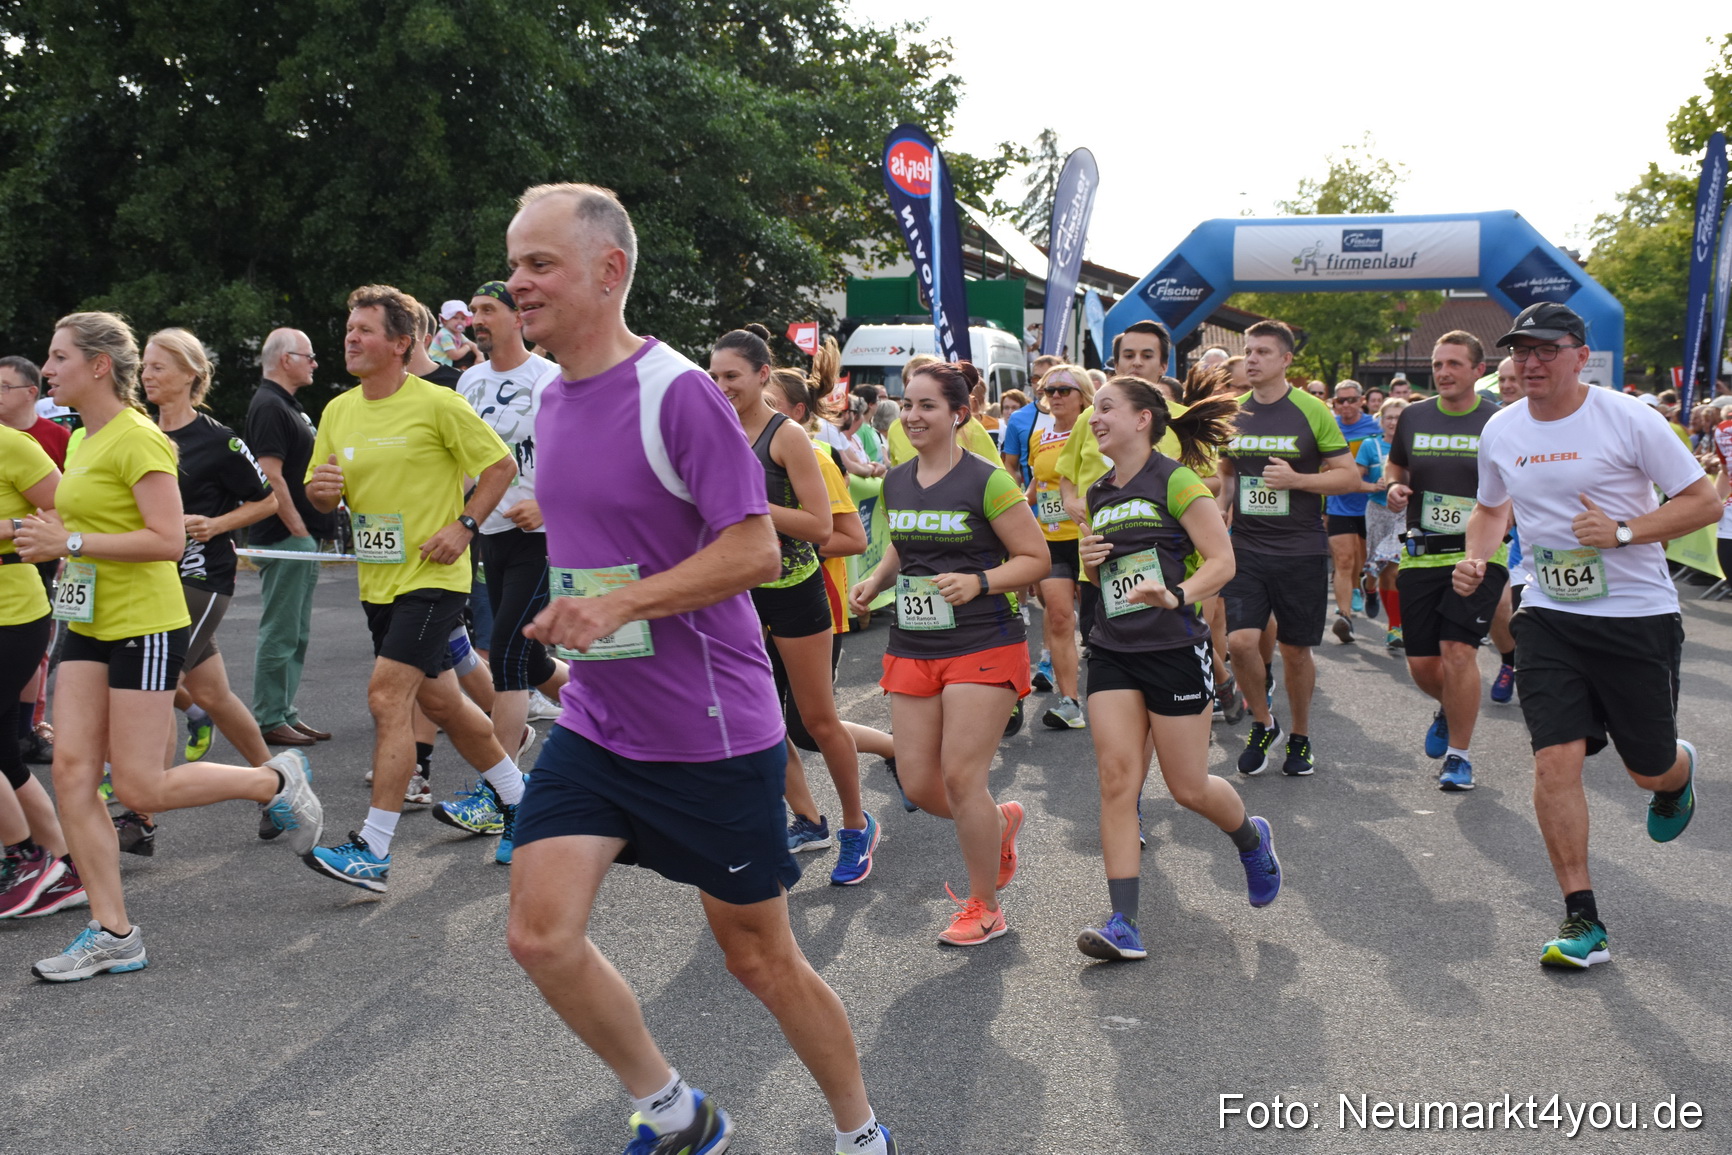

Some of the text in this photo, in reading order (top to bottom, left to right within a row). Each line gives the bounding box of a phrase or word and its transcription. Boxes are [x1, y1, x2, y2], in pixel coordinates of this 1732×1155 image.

[1326, 251, 1418, 270] firmenlauf
[1155, 282, 1204, 297] Fischer
[1228, 435, 1296, 450] BOCK
[1414, 434, 1480, 450] BOCK
[1530, 452, 1582, 464] KLEBL
[1248, 490, 1278, 505] 306
[889, 511, 967, 532] BOCK
[1092, 500, 1156, 529] OCK
[1431, 507, 1461, 525] 336
[1105, 525, 1124, 535] smart
[1124, 521, 1163, 529] concepts
[357, 530, 396, 549] 1245
[910, 533, 932, 541] smart
[934, 534, 974, 543] concepts
[1541, 565, 1595, 587] 1164
[904, 595, 934, 616] 331
[1173, 692, 1202, 701] hummel
